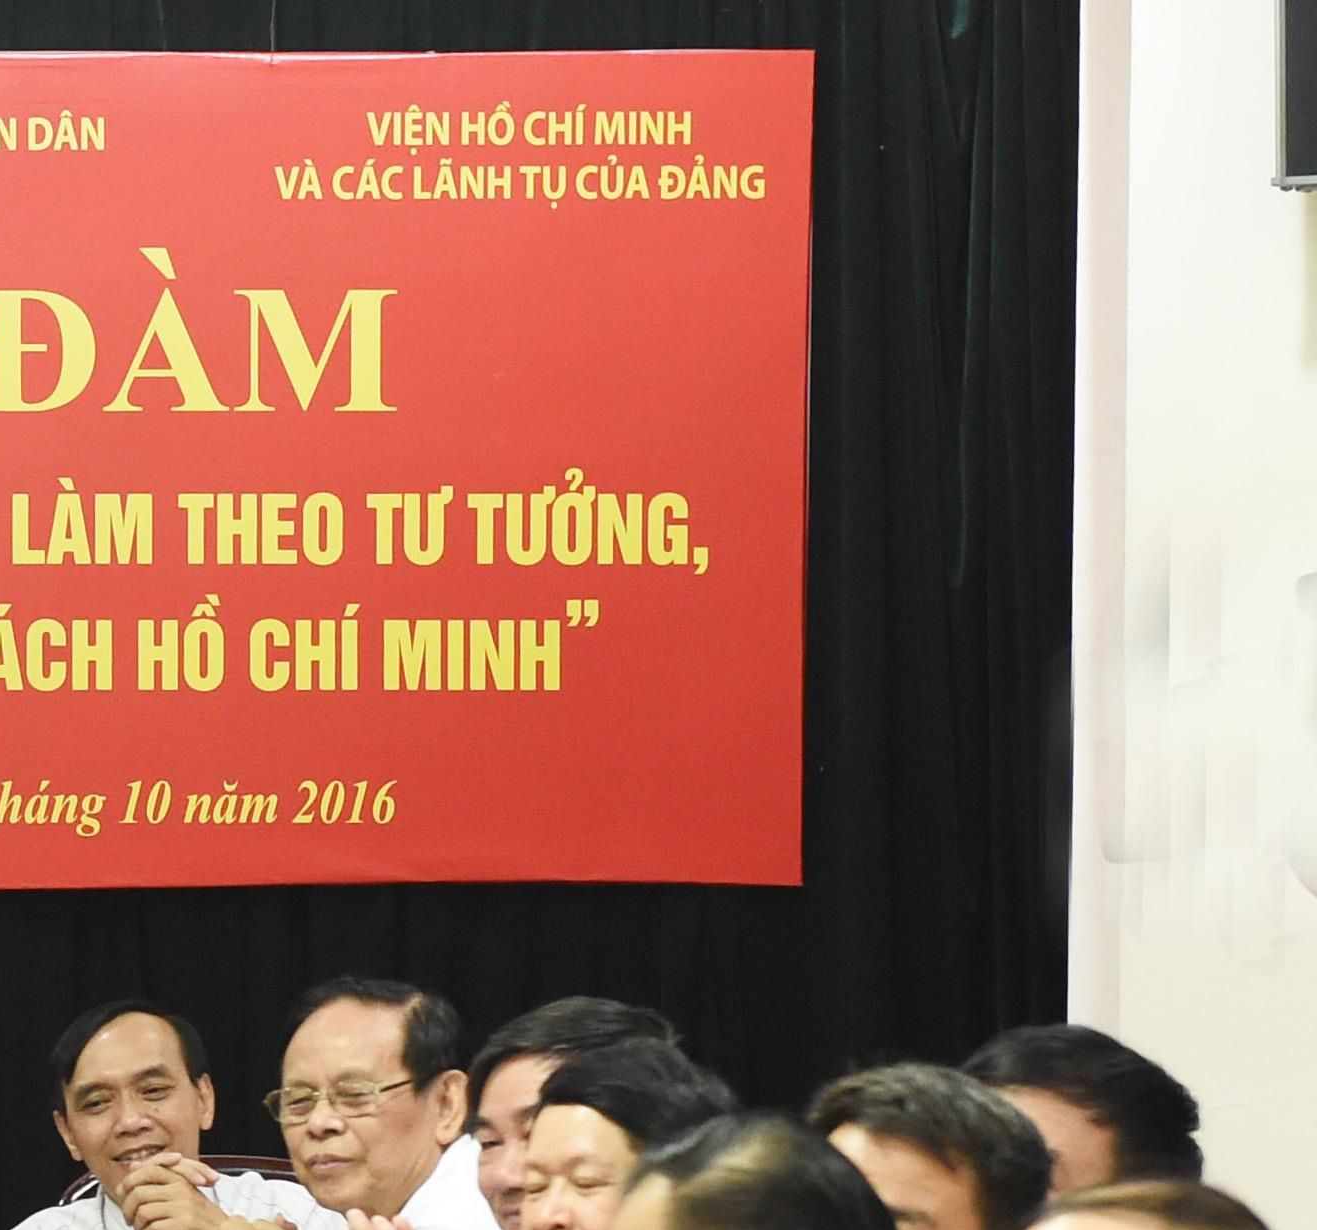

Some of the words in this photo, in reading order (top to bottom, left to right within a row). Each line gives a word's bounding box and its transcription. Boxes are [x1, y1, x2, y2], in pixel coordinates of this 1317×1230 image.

[28, 110, 105, 152] DÂN
[367, 105, 450, 157] VIỆN
[461, 100, 515, 146] HỒ
[524, 102, 586, 146] CHÍ
[595, 110, 691, 146] MINH
[276, 156, 323, 200] VÀ
[332, 156, 403, 200] CÁC
[413, 156, 511, 200] LÃNH
[520, 165, 566, 209] TỤ
[576, 154, 650, 200] CỦA
[658, 153, 765, 200] ĐẢNG
[12, 477, 152, 565] LÀM
[178, 492, 343, 566] THEO
[367, 486, 453, 566] TƯ
[468, 468, 709, 574] TƯỞNG,
[138, 594, 224, 692] HỒ
[250, 604, 358, 692] CHÍ
[384, 599, 600, 692] MINH”
[123, 780, 171, 825] 10
[184, 783, 278, 825] năm
[293, 780, 396, 825] 2016
